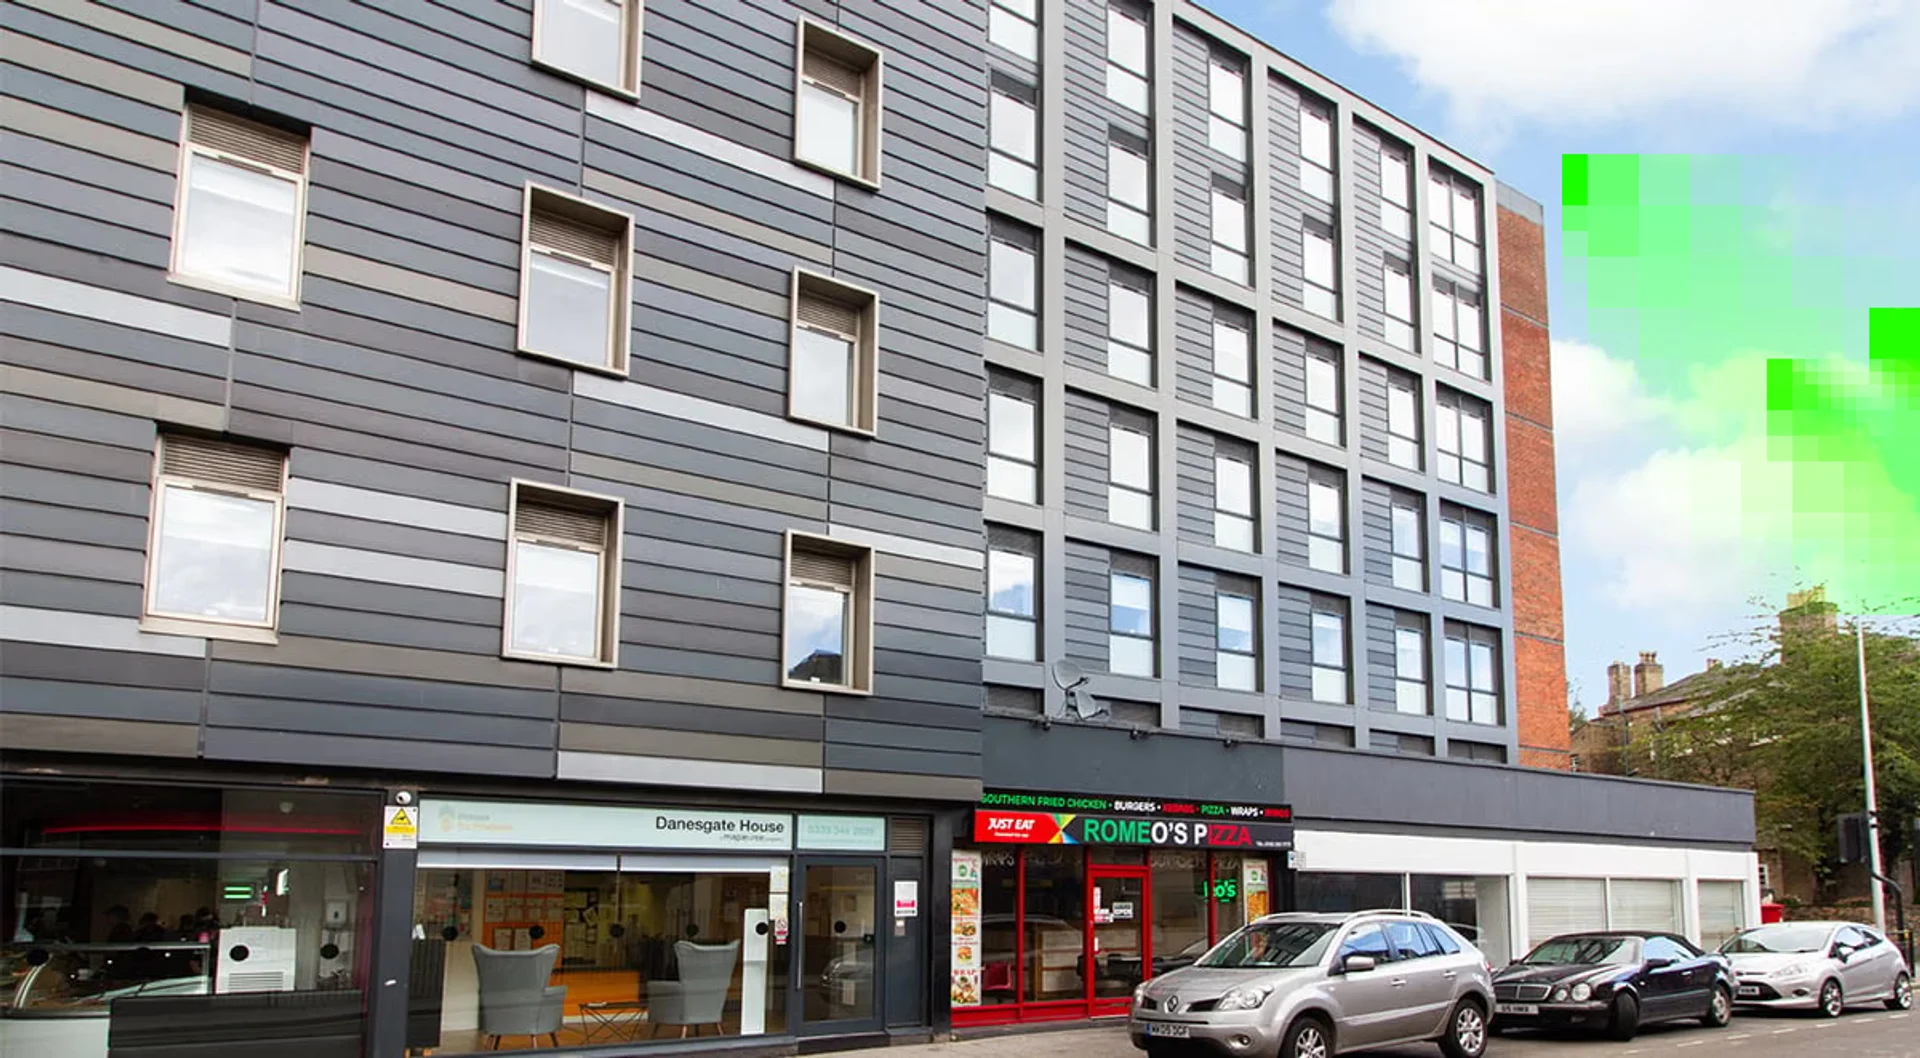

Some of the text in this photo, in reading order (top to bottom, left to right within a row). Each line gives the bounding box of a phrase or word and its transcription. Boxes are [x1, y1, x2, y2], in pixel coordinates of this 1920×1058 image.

[981, 793, 1036, 806] SOUTHERN
[1037, 796, 1065, 808] FRIED
[1067, 797, 1107, 810] CHICKEN
[1114, 800, 1156, 812] BURGERS
[1201, 804, 1225, 815] PIZZA
[1231, 806, 1259, 817] WRAPS
[655, 815, 785, 834] Danesgate House
[988, 817, 1036, 831] JUST EAT
[1084, 818, 1253, 847] ROMEO'S PIZZA
